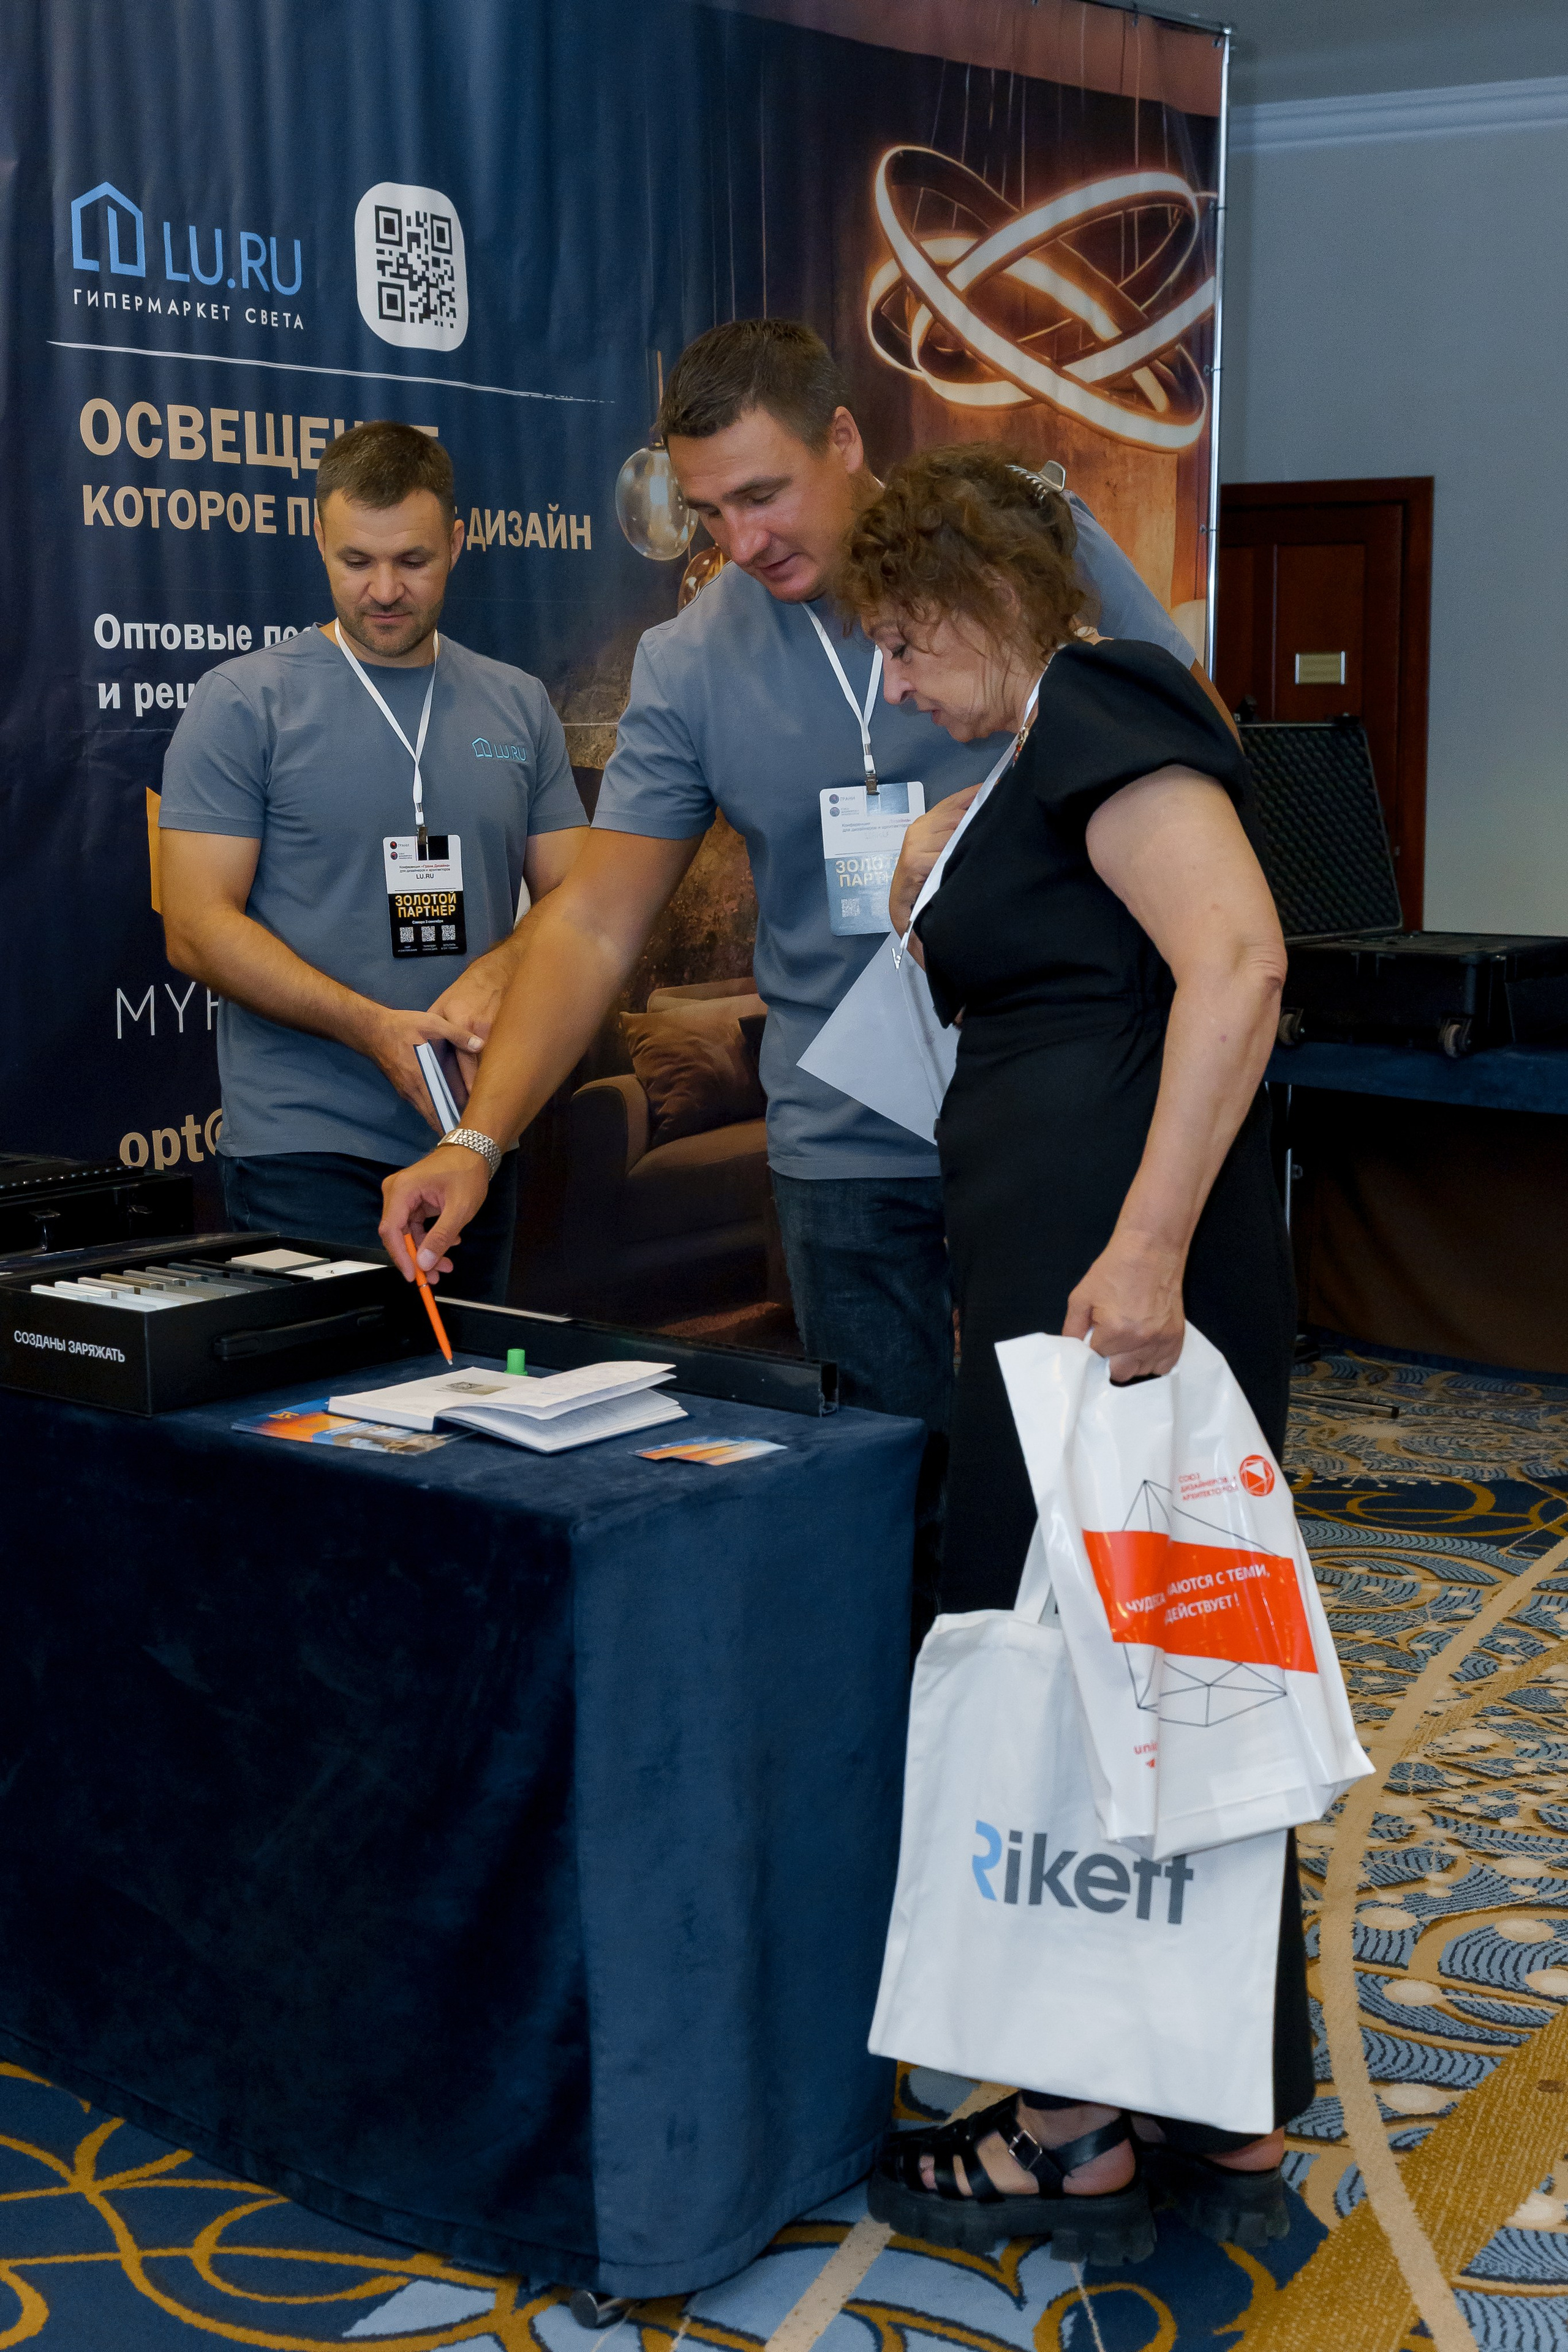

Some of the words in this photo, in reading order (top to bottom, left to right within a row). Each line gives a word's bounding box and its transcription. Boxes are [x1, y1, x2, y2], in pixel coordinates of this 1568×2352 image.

[163, 221, 302, 295] LU.RU
[74, 288, 231, 322] ГИПЕРМАРКЕТ
[245, 307, 304, 330] СВЕТА
[80, 398, 439, 480] ОСВЕЩЕ
[83, 484, 277, 534] КОТОРОЕ
[467, 503, 592, 552] ДИЗАЙН
[94, 613, 252, 651] Оптовые
[98, 683, 121, 709] и
[835, 855, 899, 873] ЗОЛОТ
[395, 891, 456, 907] ЗОЛОТОЙ
[398, 905, 456, 918] ПАРТНЕР
[14, 1330, 66, 1351] СОЗДАНЫ
[68, 1341, 126, 1362] ЗАРЯЖАТЬ
[1216, 1572, 1226, 1585] С
